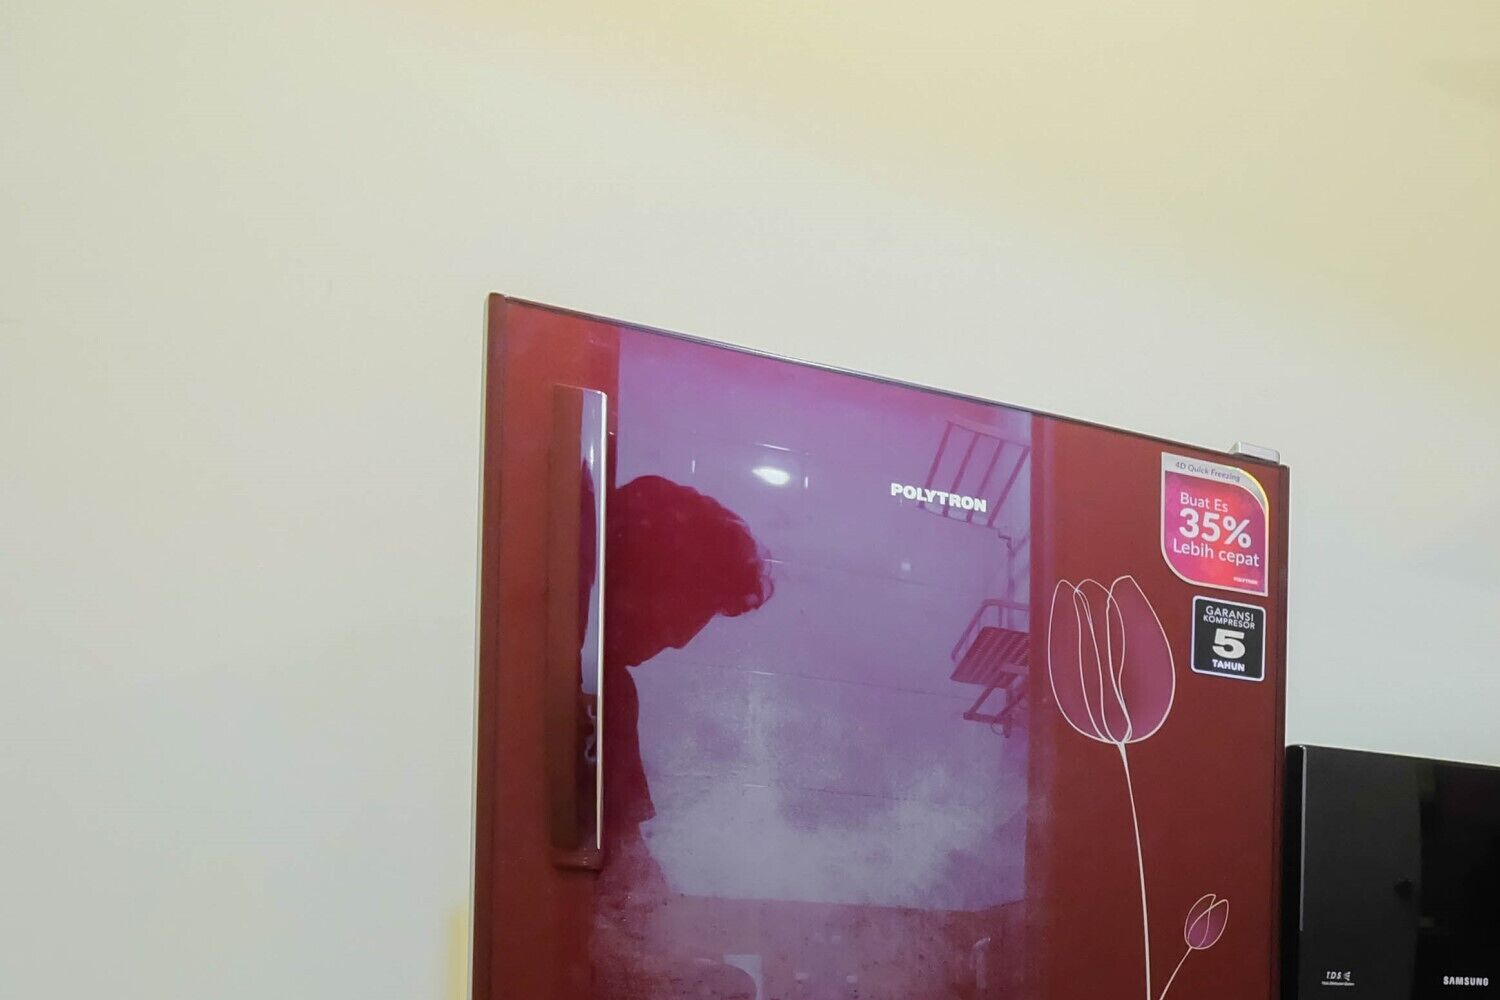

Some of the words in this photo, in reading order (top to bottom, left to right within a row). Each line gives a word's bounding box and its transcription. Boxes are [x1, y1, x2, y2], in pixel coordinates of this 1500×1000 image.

[1187, 464, 1209, 475] Quick
[1211, 468, 1240, 483] Freezing
[890, 482, 987, 513] POLYTRON
[1180, 491, 1210, 509] Buat
[1214, 498, 1229, 513] Es
[1179, 508, 1252, 549] 35%
[1173, 537, 1214, 559] Lebih
[1218, 550, 1260, 567] cepat
[1203, 614, 1255, 630] KOMPRESOR
[1205, 605, 1254, 622] GARANSI
[1212, 628, 1246, 659] 5
[1212, 658, 1246, 672] TAHUN
[1443, 975, 1489, 987] SAMSUNG
